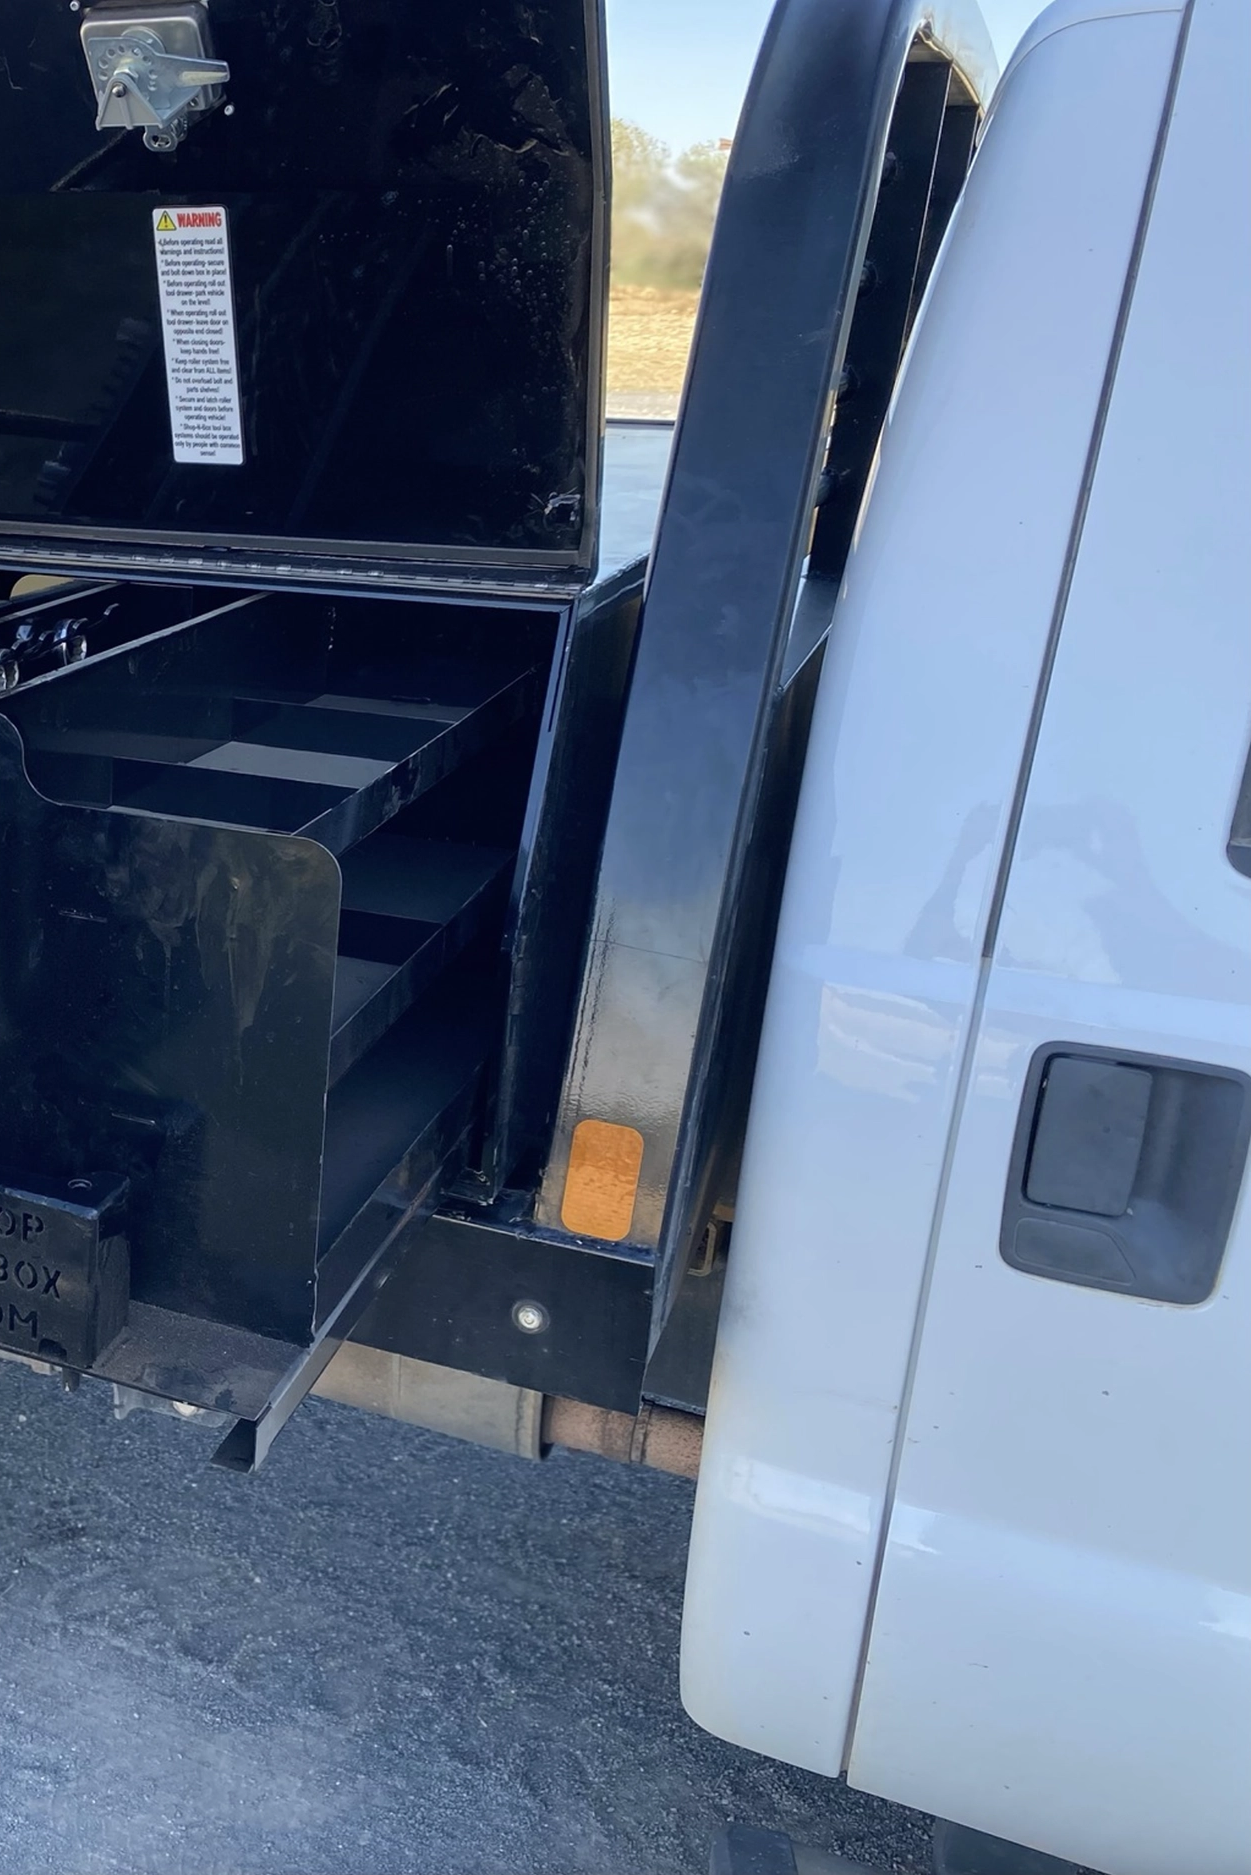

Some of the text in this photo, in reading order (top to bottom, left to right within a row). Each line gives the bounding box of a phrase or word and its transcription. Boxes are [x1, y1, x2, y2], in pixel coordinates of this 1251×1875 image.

[177, 212, 222, 228] WARNING
[181, 238, 204, 246] operating
[184, 280, 207, 288] operating
[195, 289, 206, 297] park
[185, 309, 208, 318] operating
[191, 339, 208, 347] closing
[202, 358, 218, 366] system
